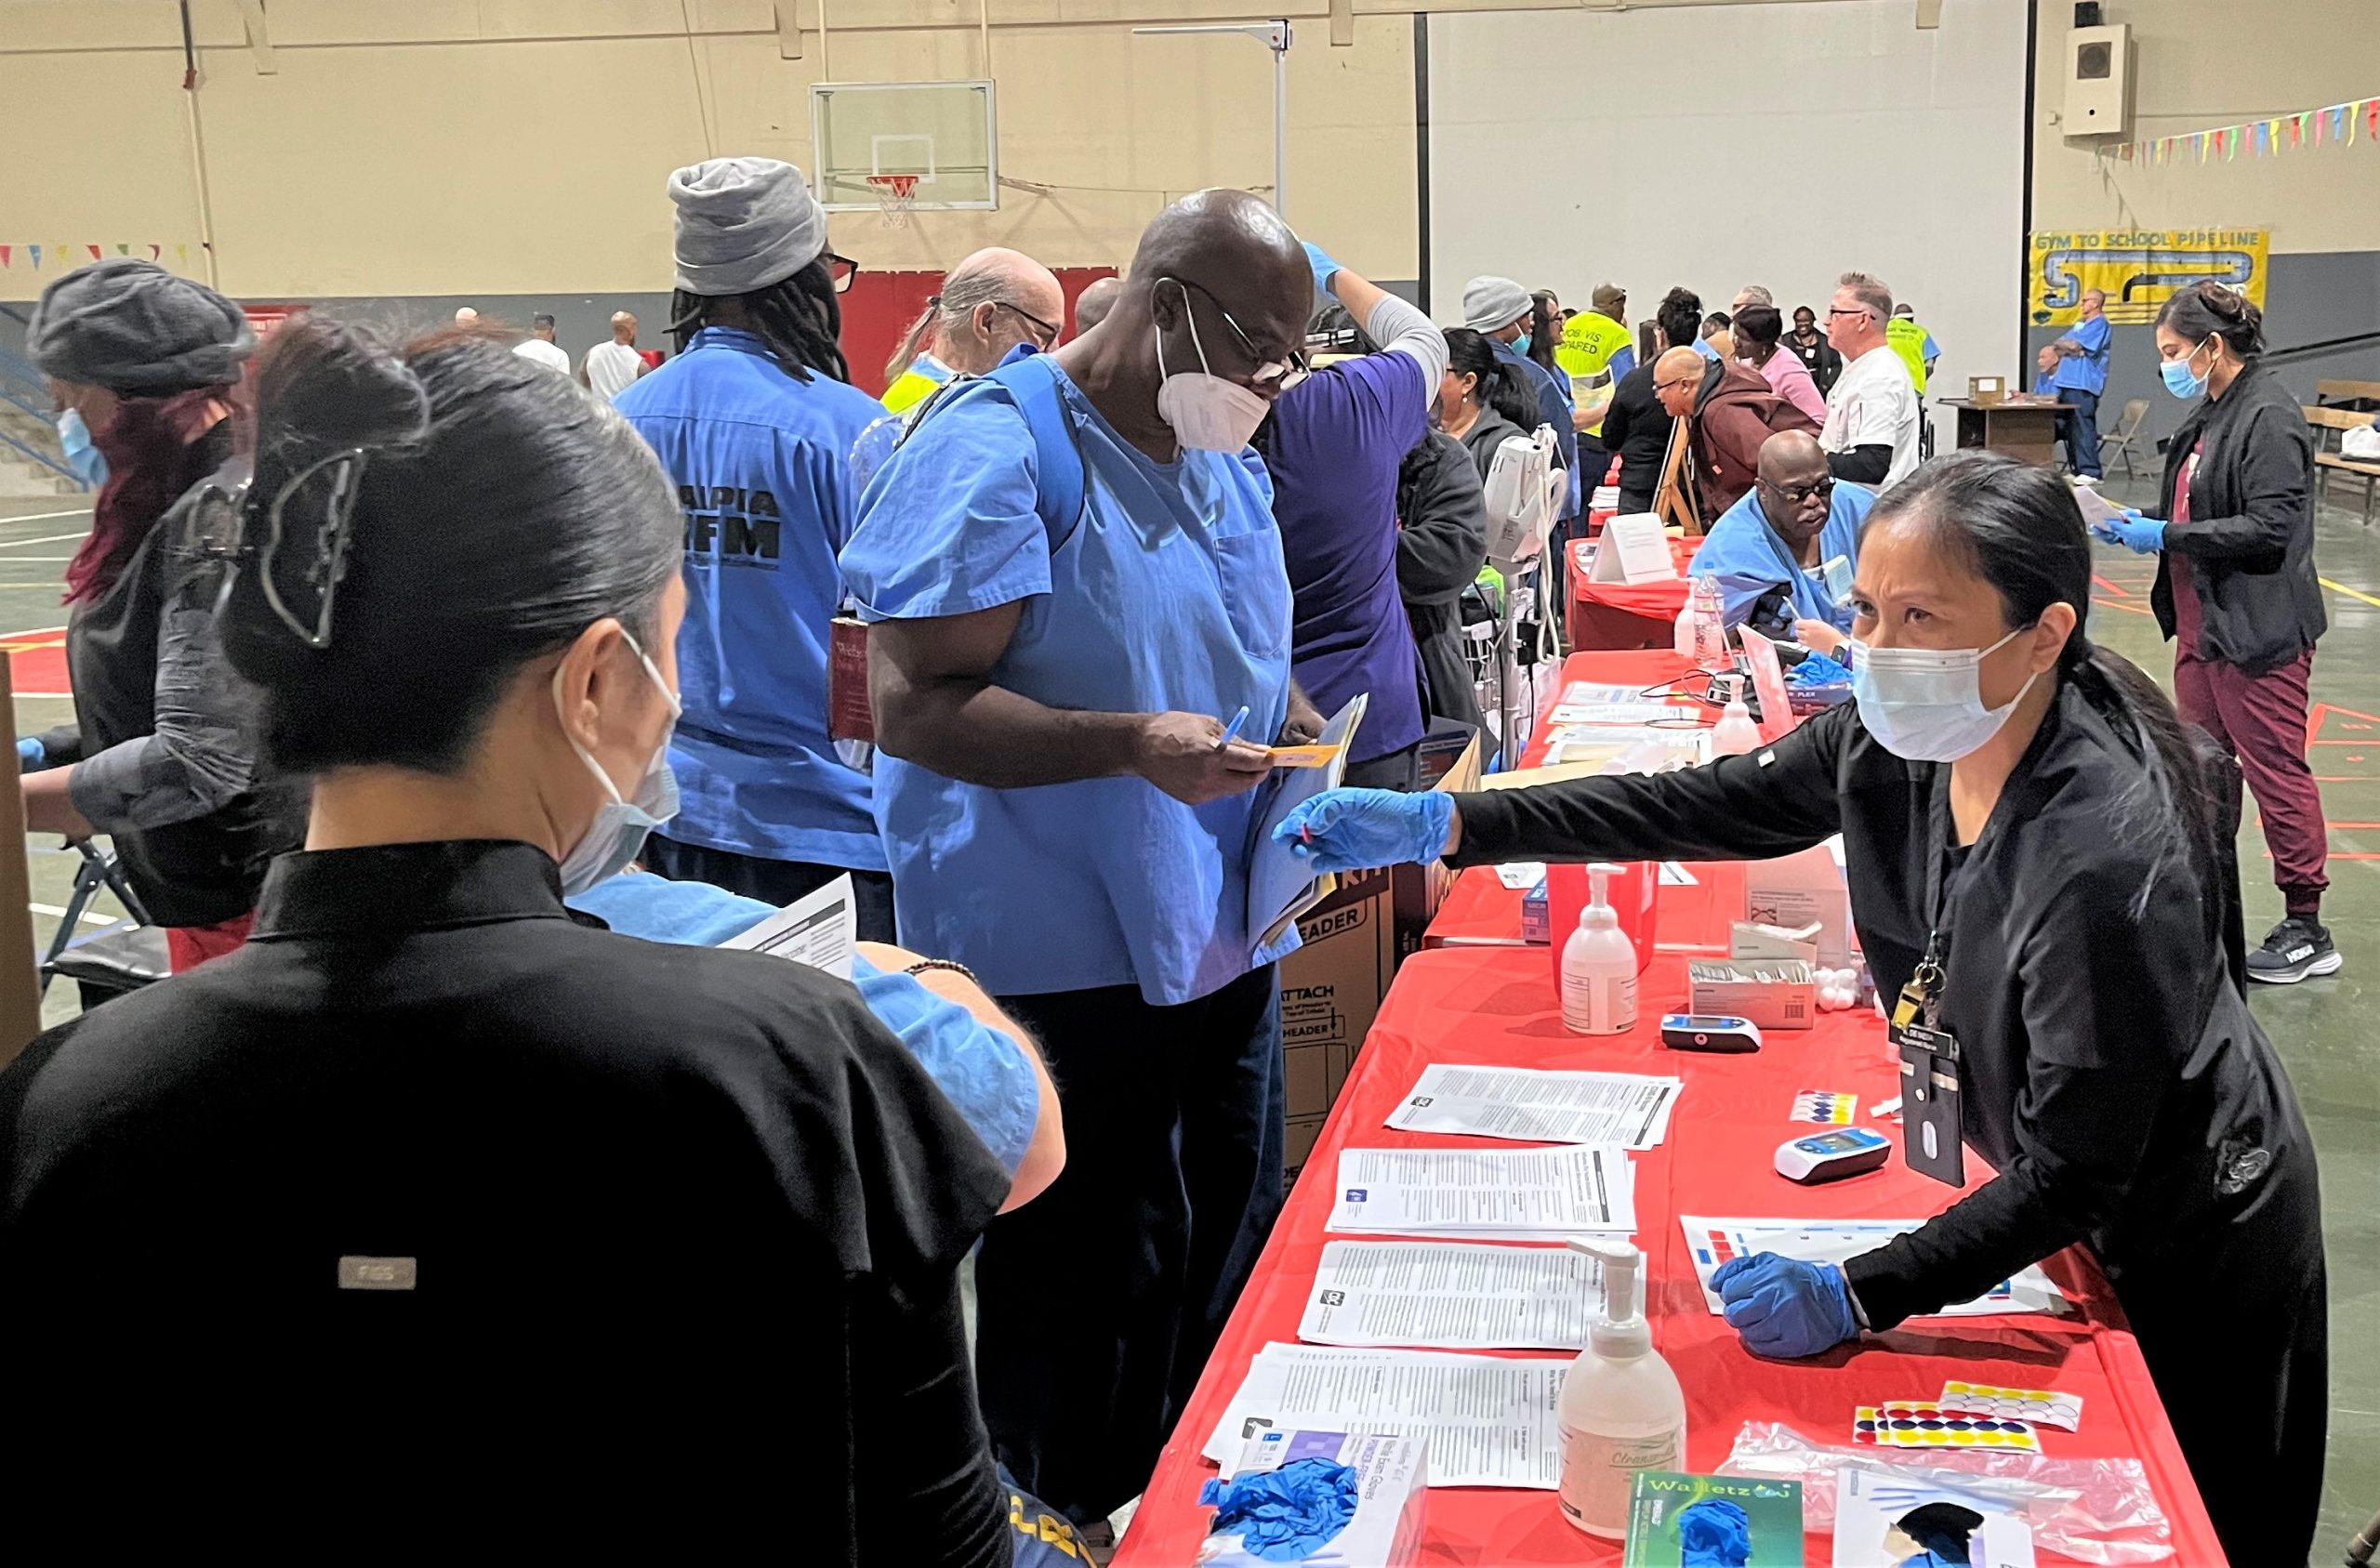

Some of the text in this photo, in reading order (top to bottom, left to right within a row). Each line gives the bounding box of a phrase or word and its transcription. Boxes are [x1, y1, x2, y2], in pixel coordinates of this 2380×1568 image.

[2036, 231, 2259, 249] GYM TO SCHOOL PIPELINE
[1586, 330, 1602, 342] VIS
[1298, 908, 1358, 942] EADER
[1283, 1024, 1329, 1038] HEADER
[1364, 1475, 1383, 1500] Gloves
